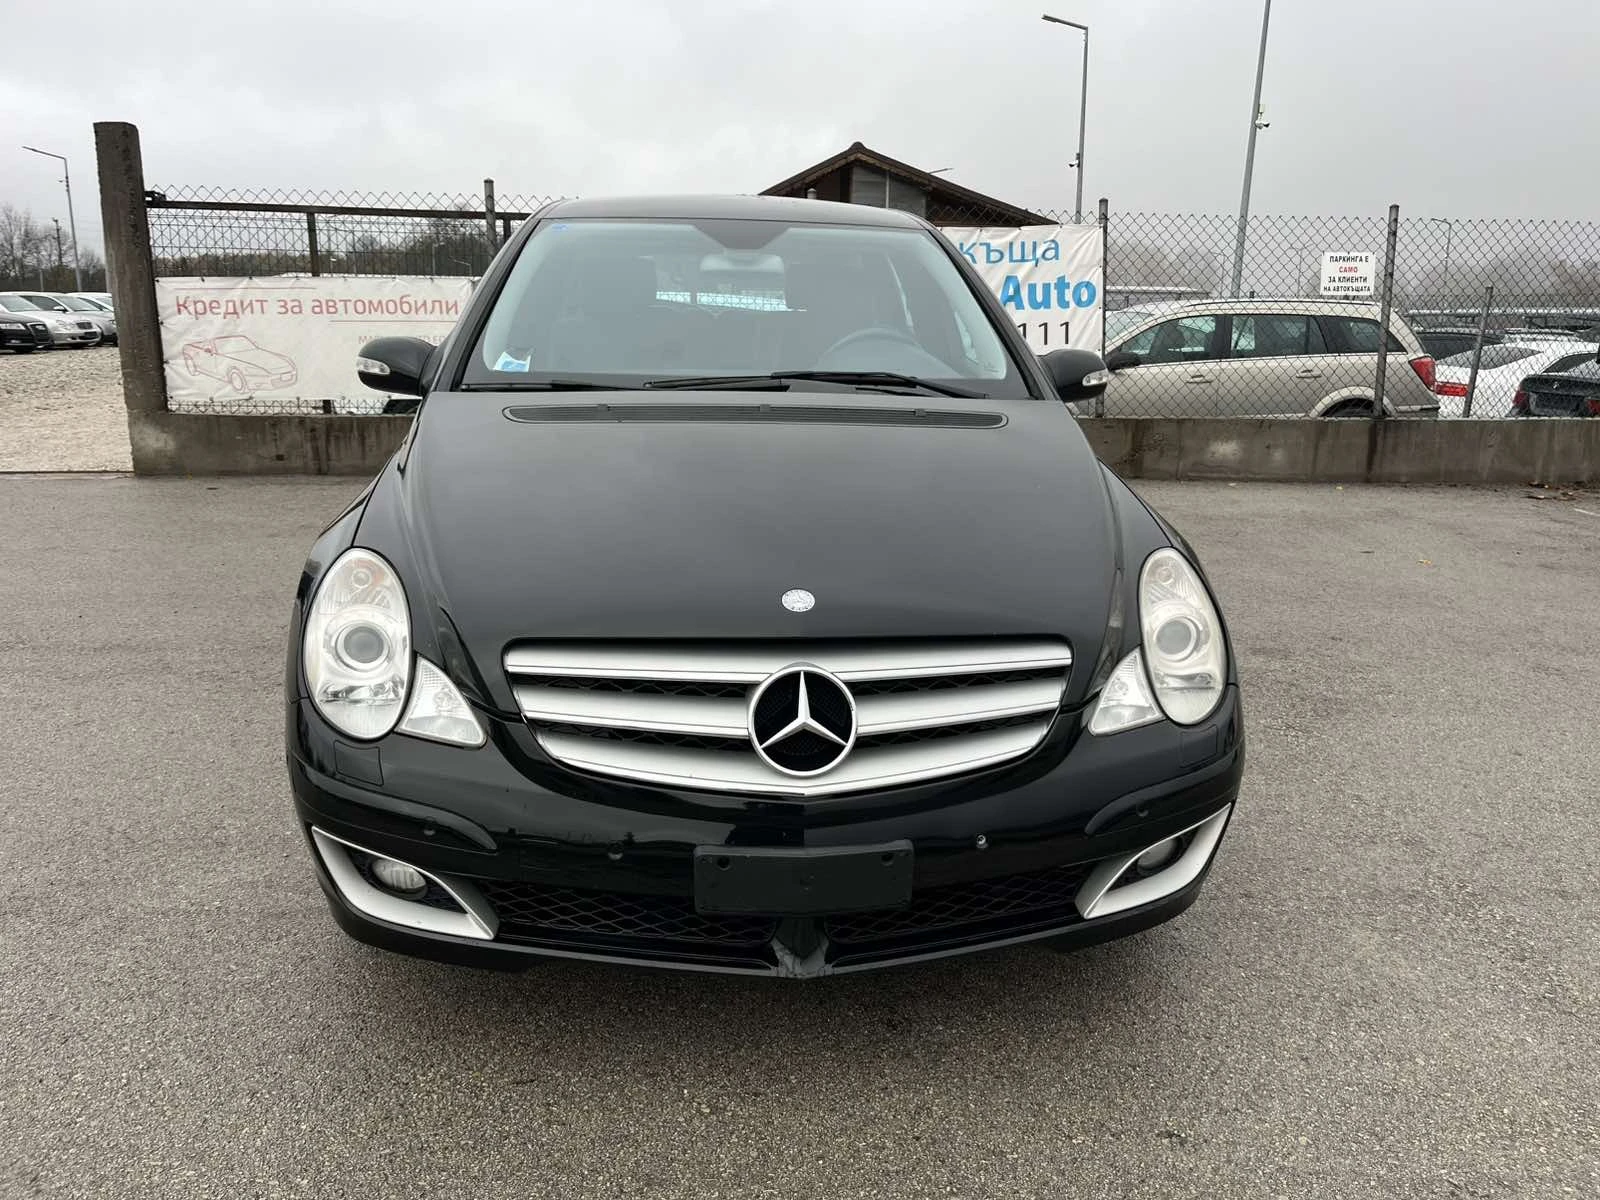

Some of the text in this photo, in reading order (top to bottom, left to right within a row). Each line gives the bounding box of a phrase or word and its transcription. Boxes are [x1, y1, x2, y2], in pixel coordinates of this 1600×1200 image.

[959, 239, 1060, 267] къща
[1001, 274, 1097, 310] Auto
[175, 294, 458, 320] Кредит за автомобили
